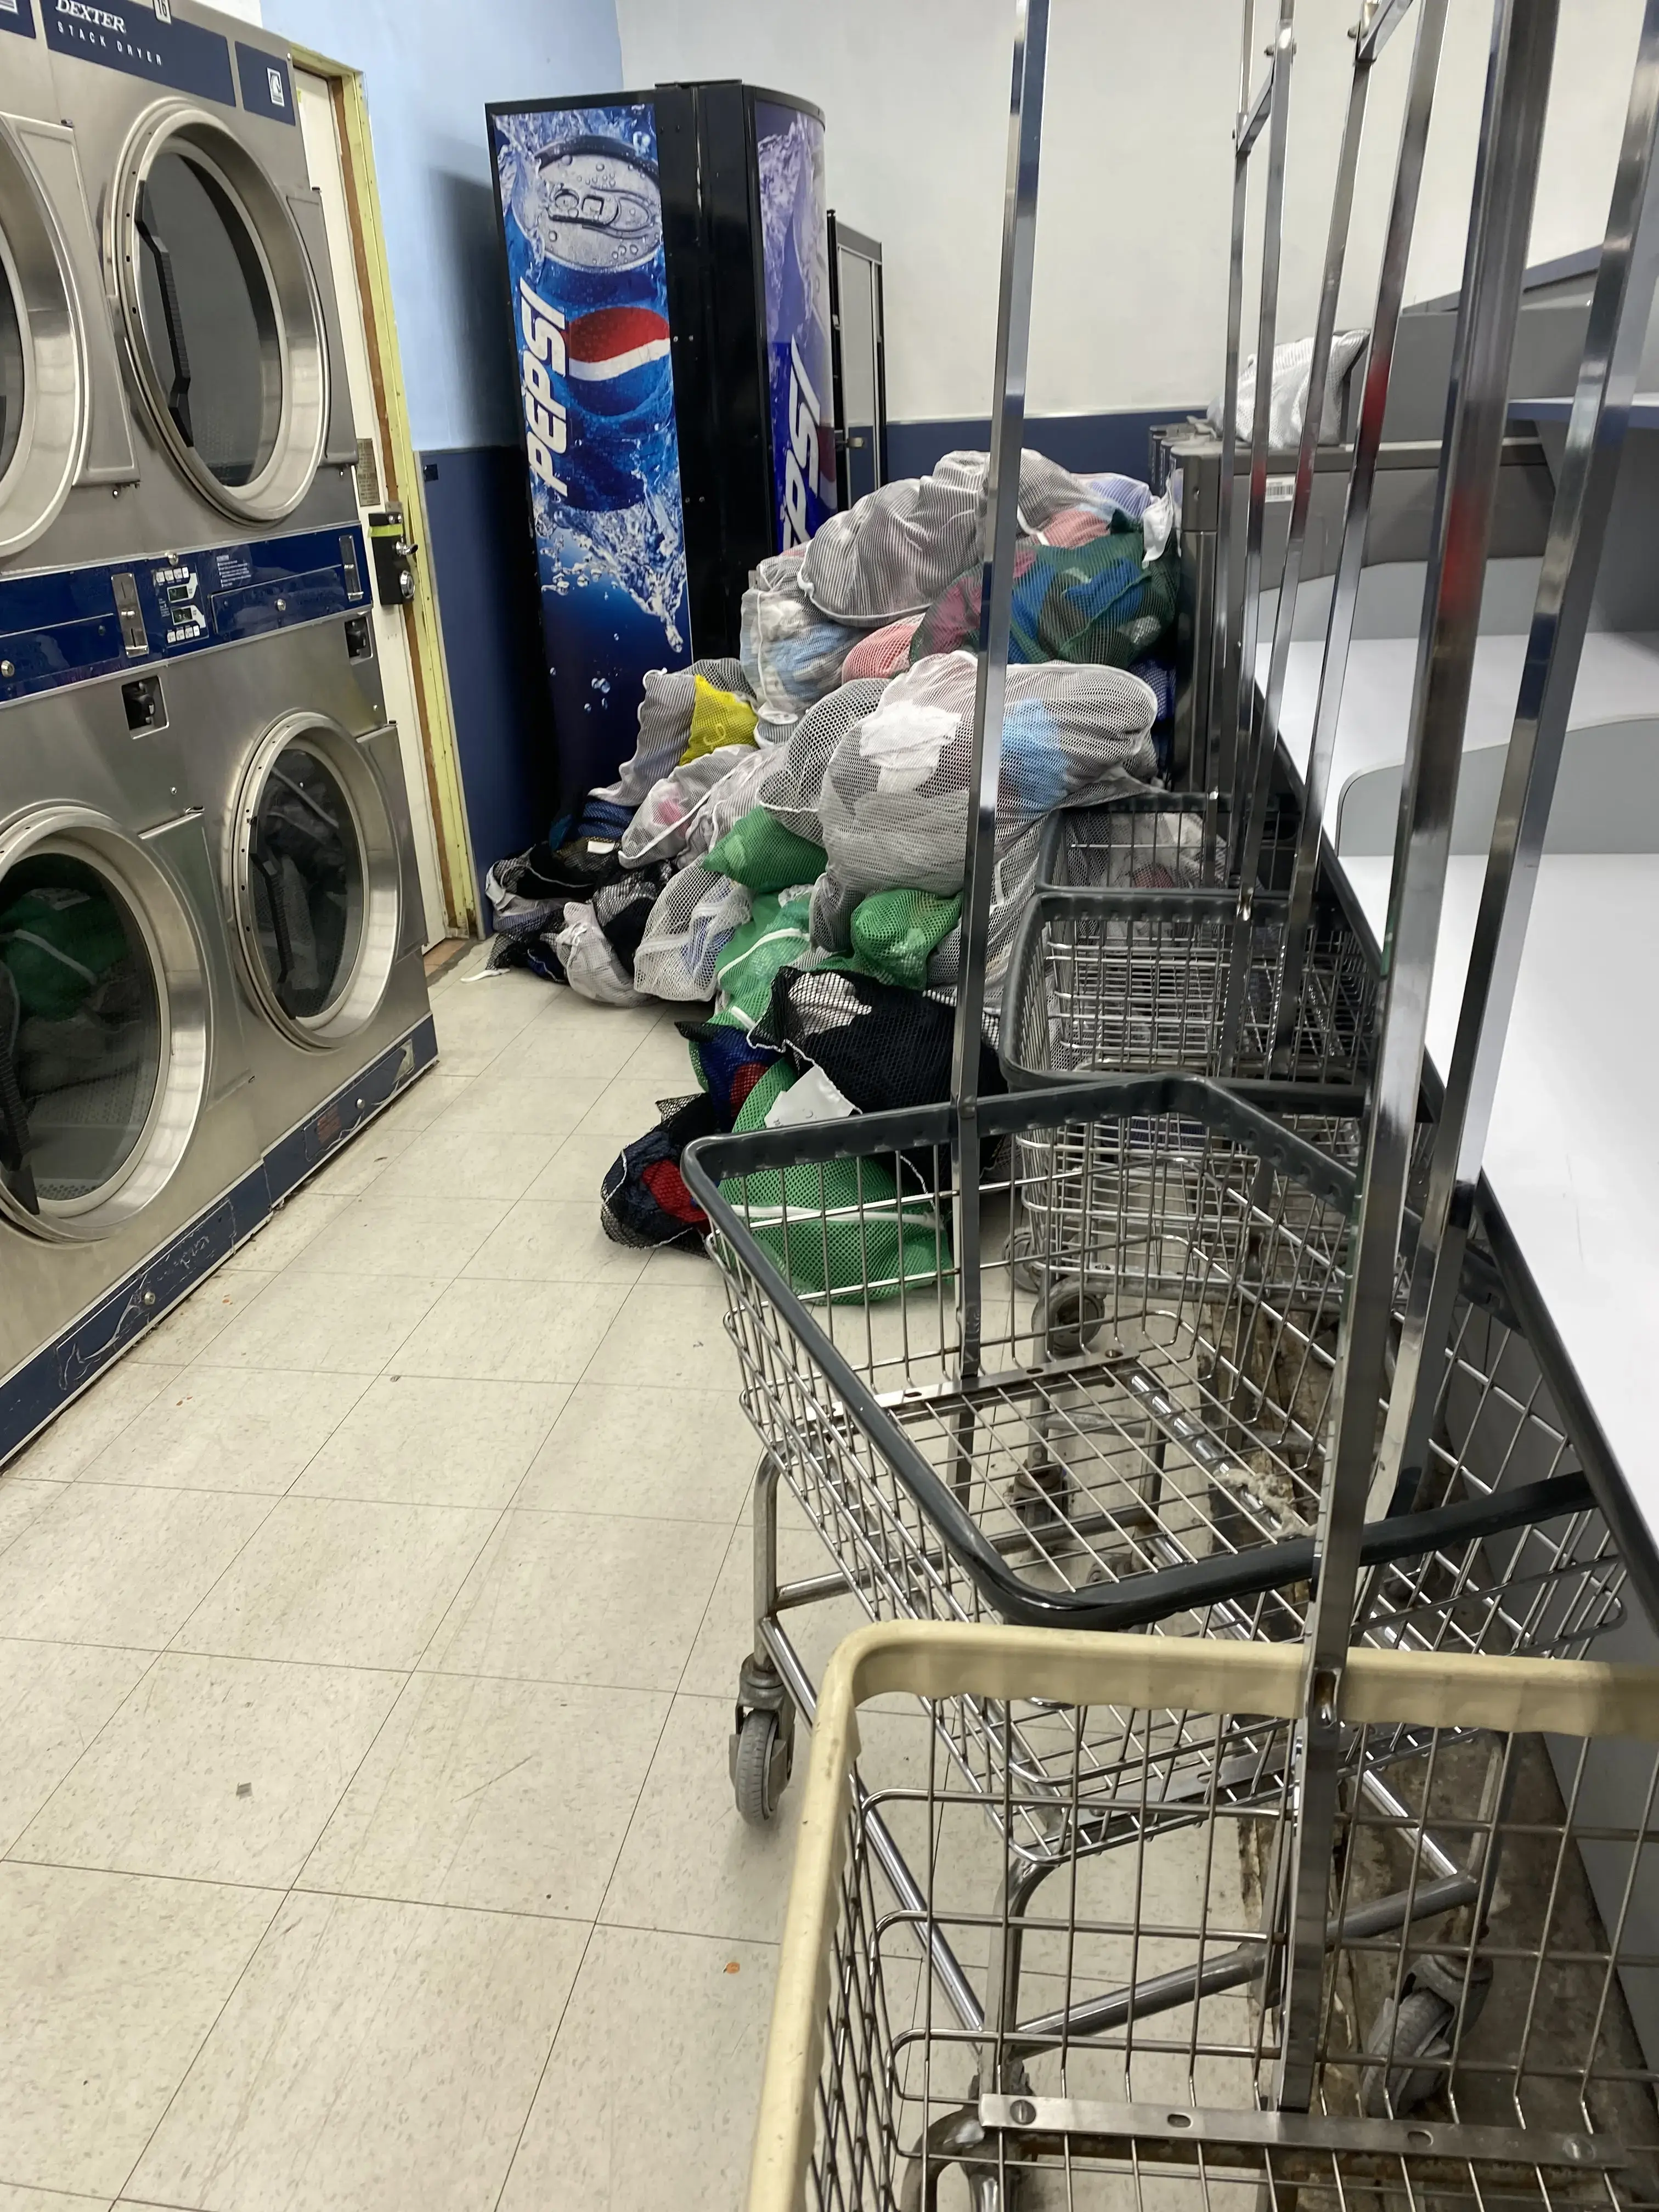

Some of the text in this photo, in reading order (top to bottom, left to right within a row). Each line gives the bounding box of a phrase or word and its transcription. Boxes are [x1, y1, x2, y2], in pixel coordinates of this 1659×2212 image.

[55, 0, 127, 33] DEXTER
[57, 21, 162, 66] STACK DRYER
[520, 276, 568, 497] PEPSI
[782, 333, 820, 549] PSI
